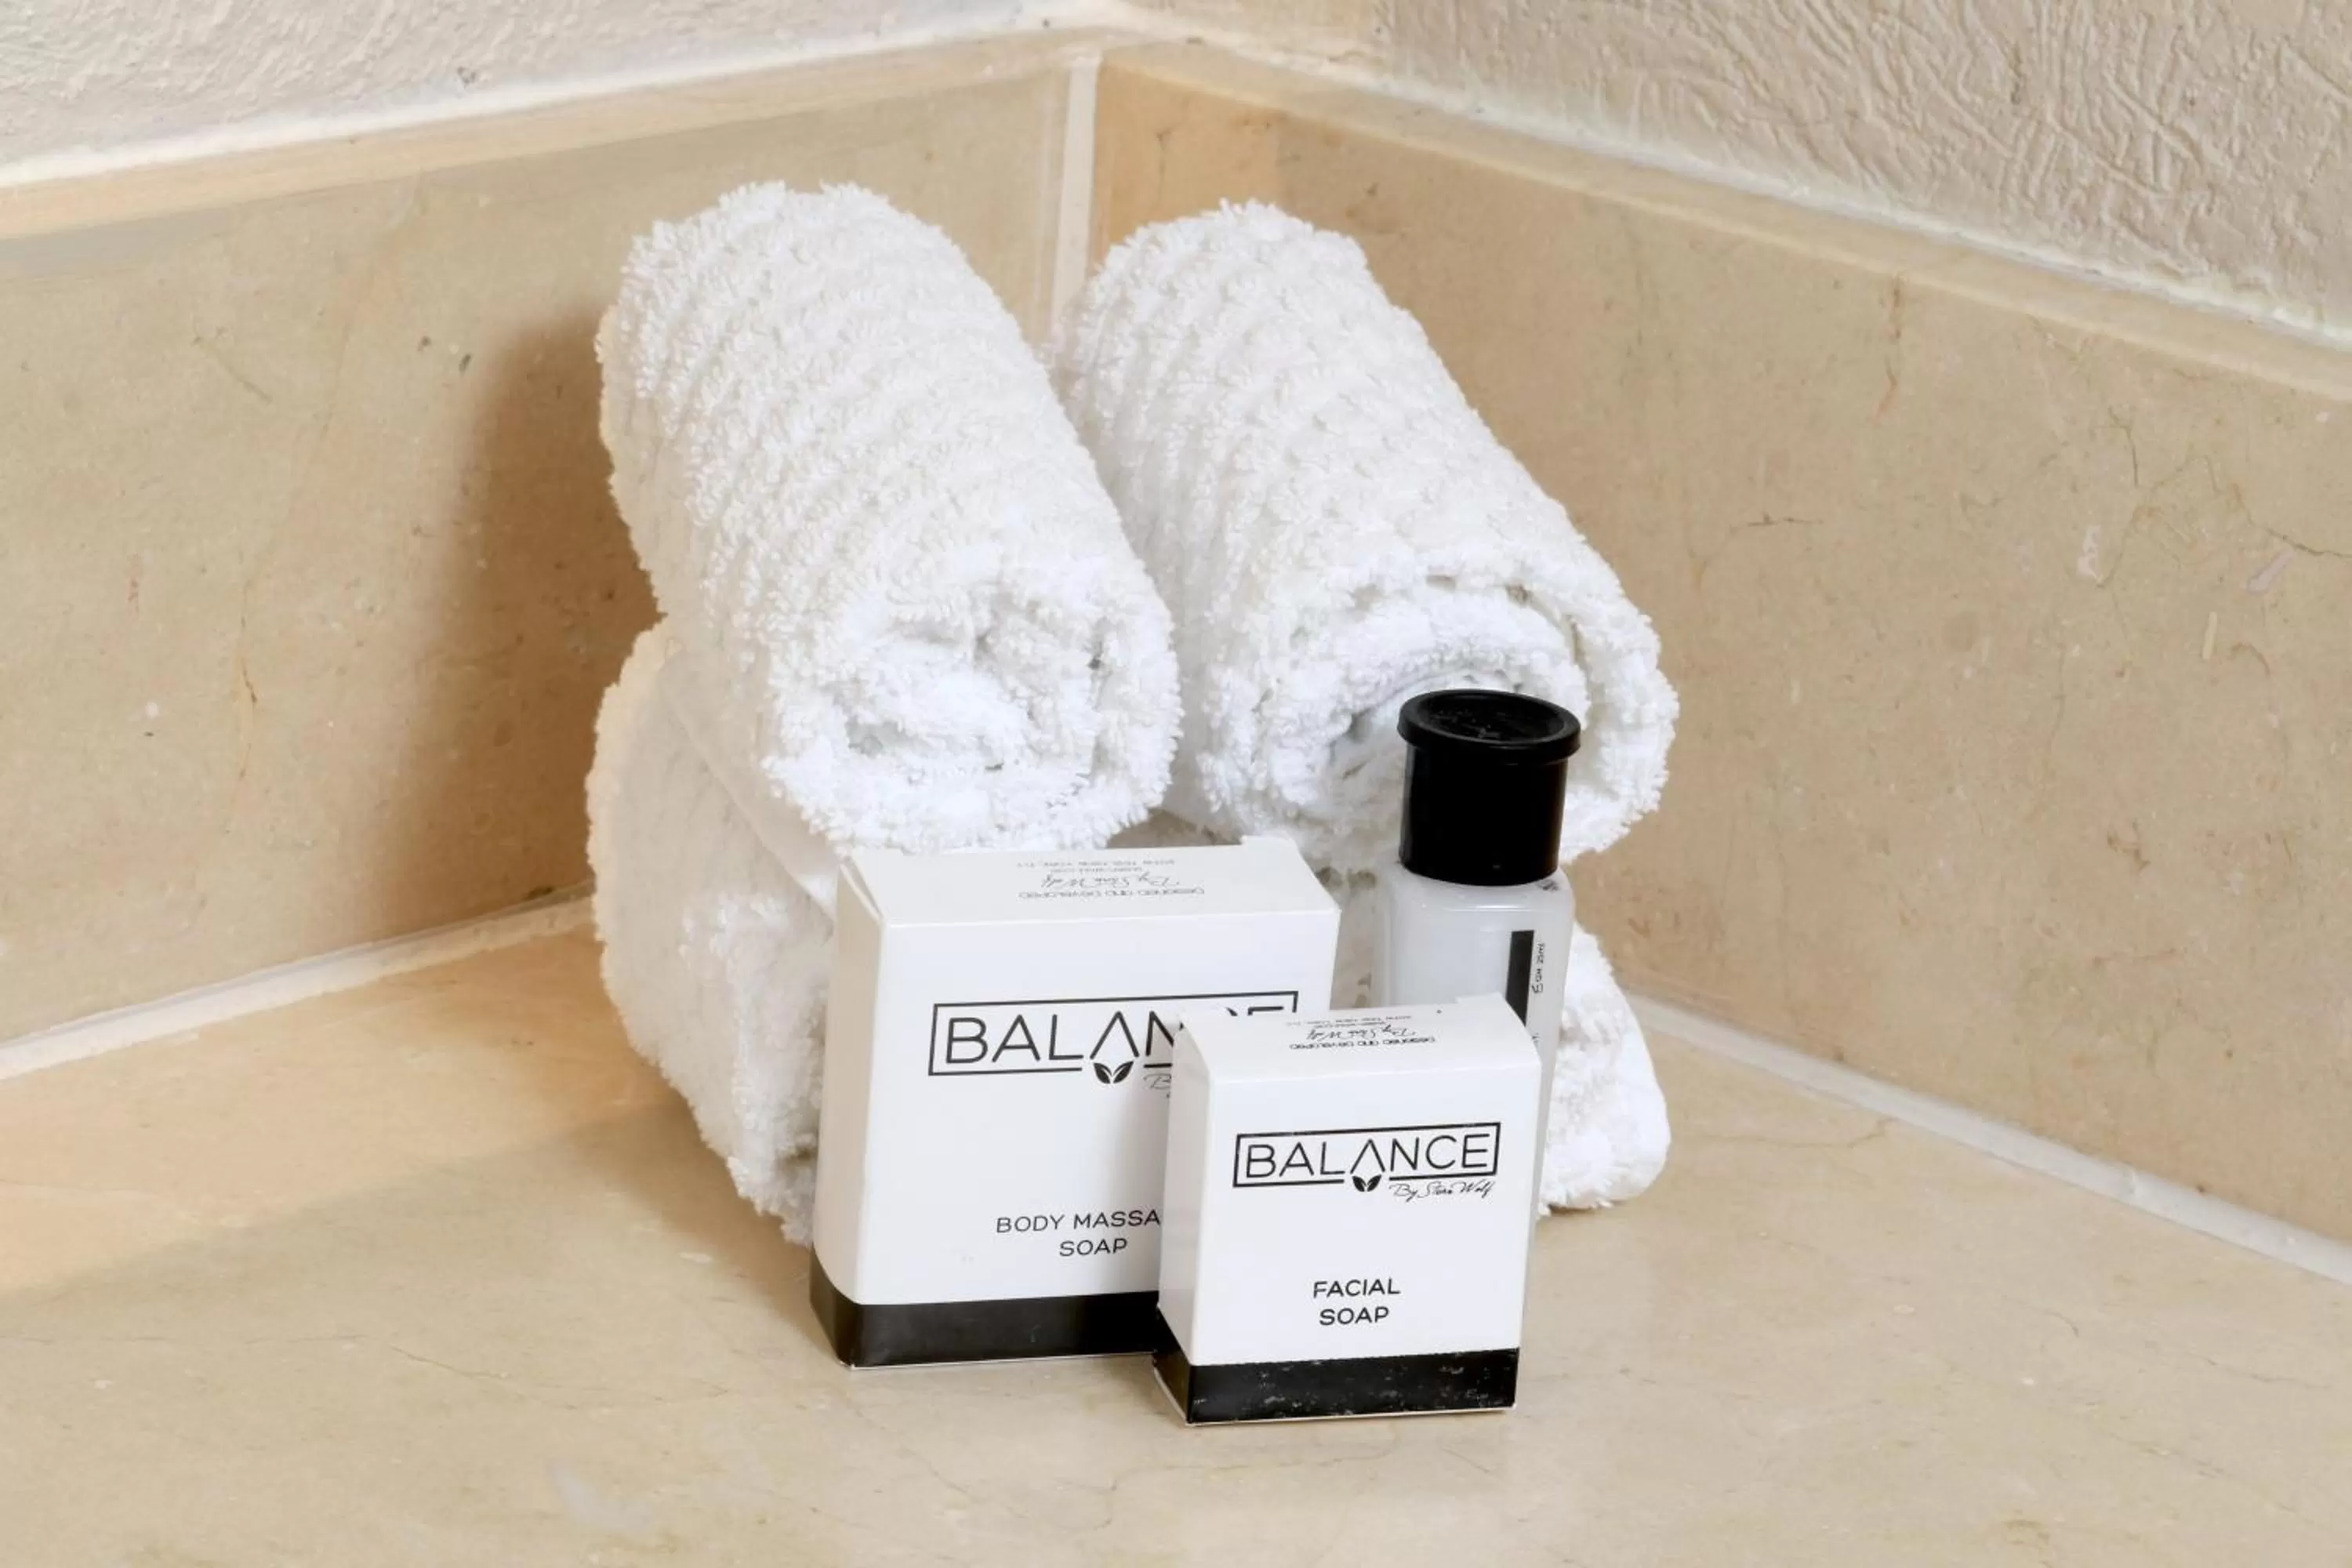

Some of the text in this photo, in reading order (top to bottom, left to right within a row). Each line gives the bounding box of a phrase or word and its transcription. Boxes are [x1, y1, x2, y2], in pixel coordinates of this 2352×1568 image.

[946, 1005, 1284, 1065] BALAN
[1143, 1073, 1172, 1099] B
[1247, 1134, 1491, 1178] BALANCE
[1388, 1182, 1418, 1203] By
[996, 1210, 1161, 1233] BODY MASSA
[1059, 1238, 1128, 1257] SOAP
[1312, 1277, 1401, 1299] FACIAL
[1319, 1306, 1389, 1326] SOAP
